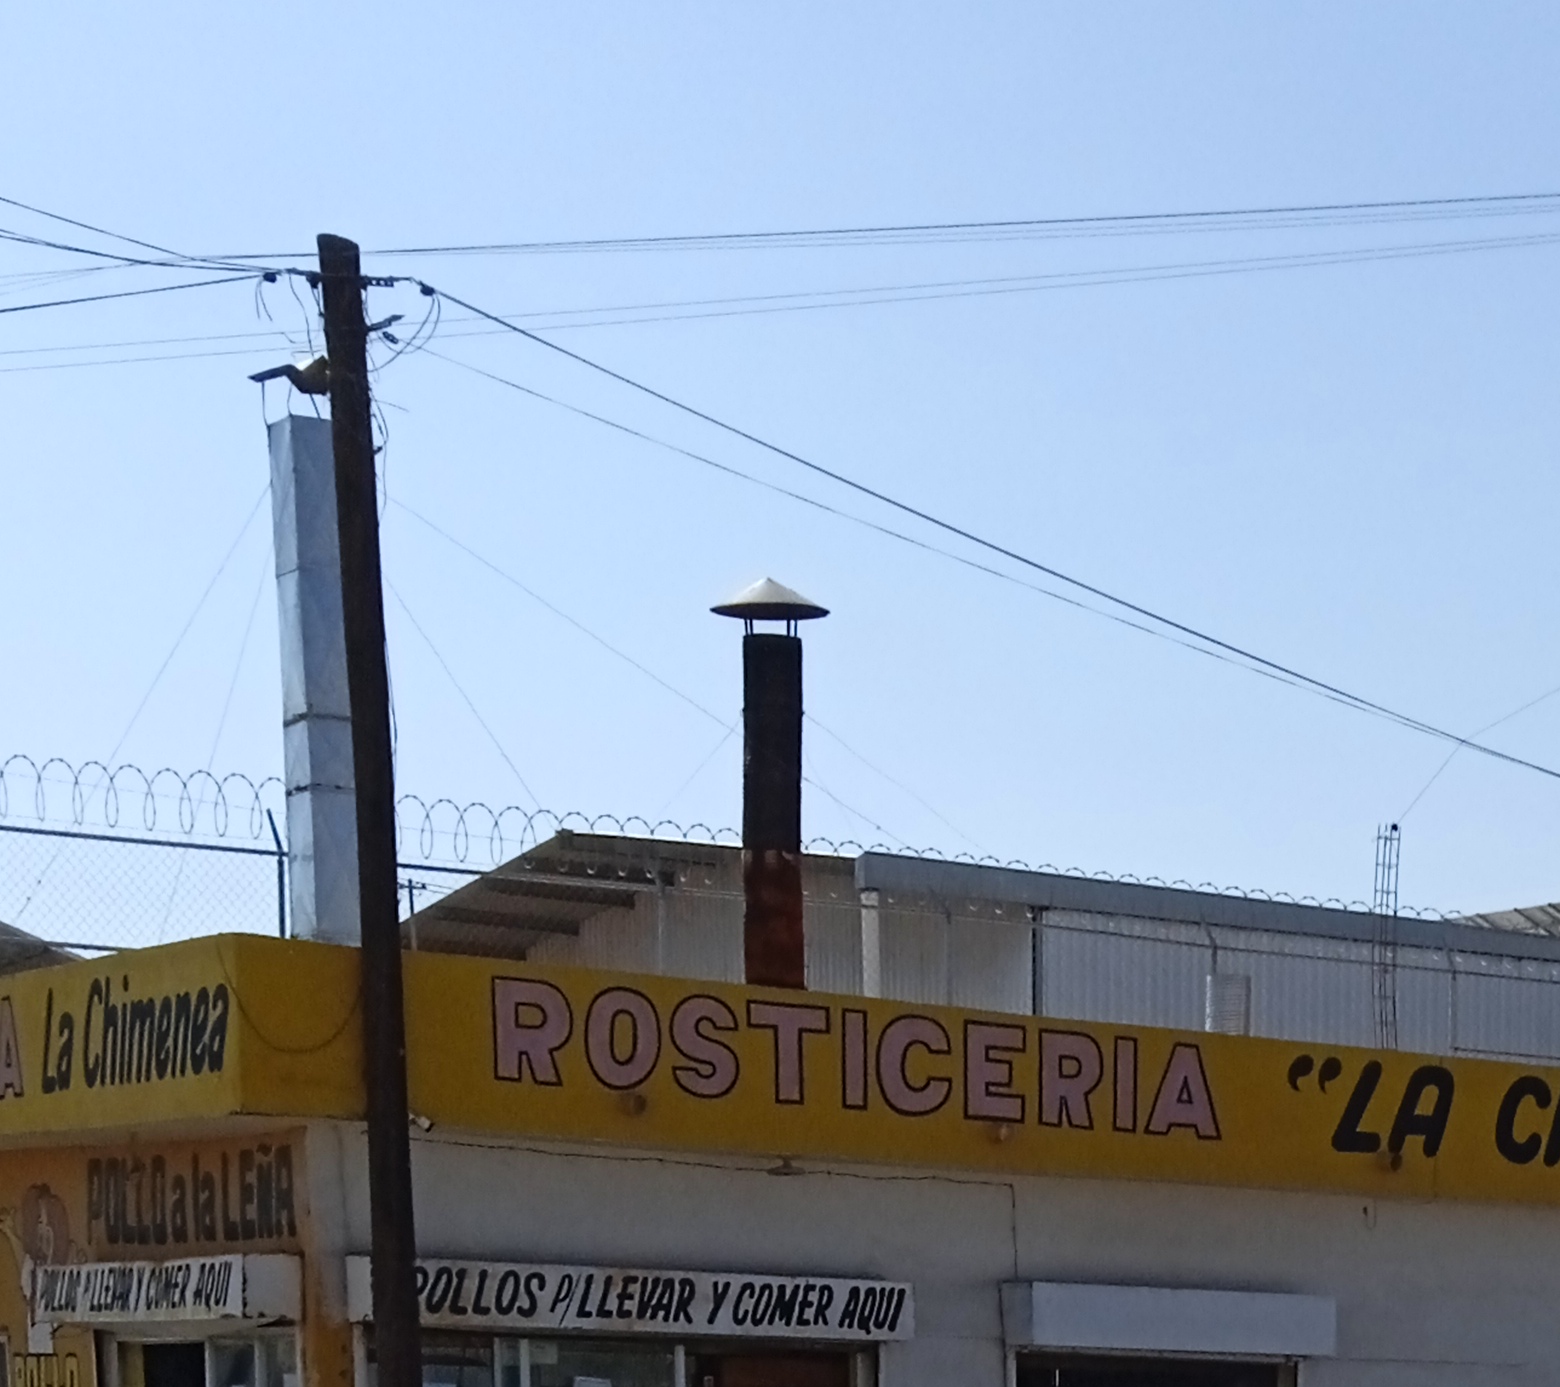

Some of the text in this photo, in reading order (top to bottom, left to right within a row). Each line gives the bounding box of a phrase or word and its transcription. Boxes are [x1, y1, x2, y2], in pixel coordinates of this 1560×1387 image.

[42, 987, 75, 1094] La
[84, 974, 229, 1088] Chimenea
[492, 975, 1222, 1141] ROSTICERIA
[88, 1143, 297, 1245] POLLO a la LEÑA
[146, 1264, 190, 1311] COMER
[193, 1261, 232, 1311] AQUI
[708, 1280, 733, 1325] Y
[733, 1280, 831, 1328] COMER
[839, 1285, 907, 1335] AQUI
